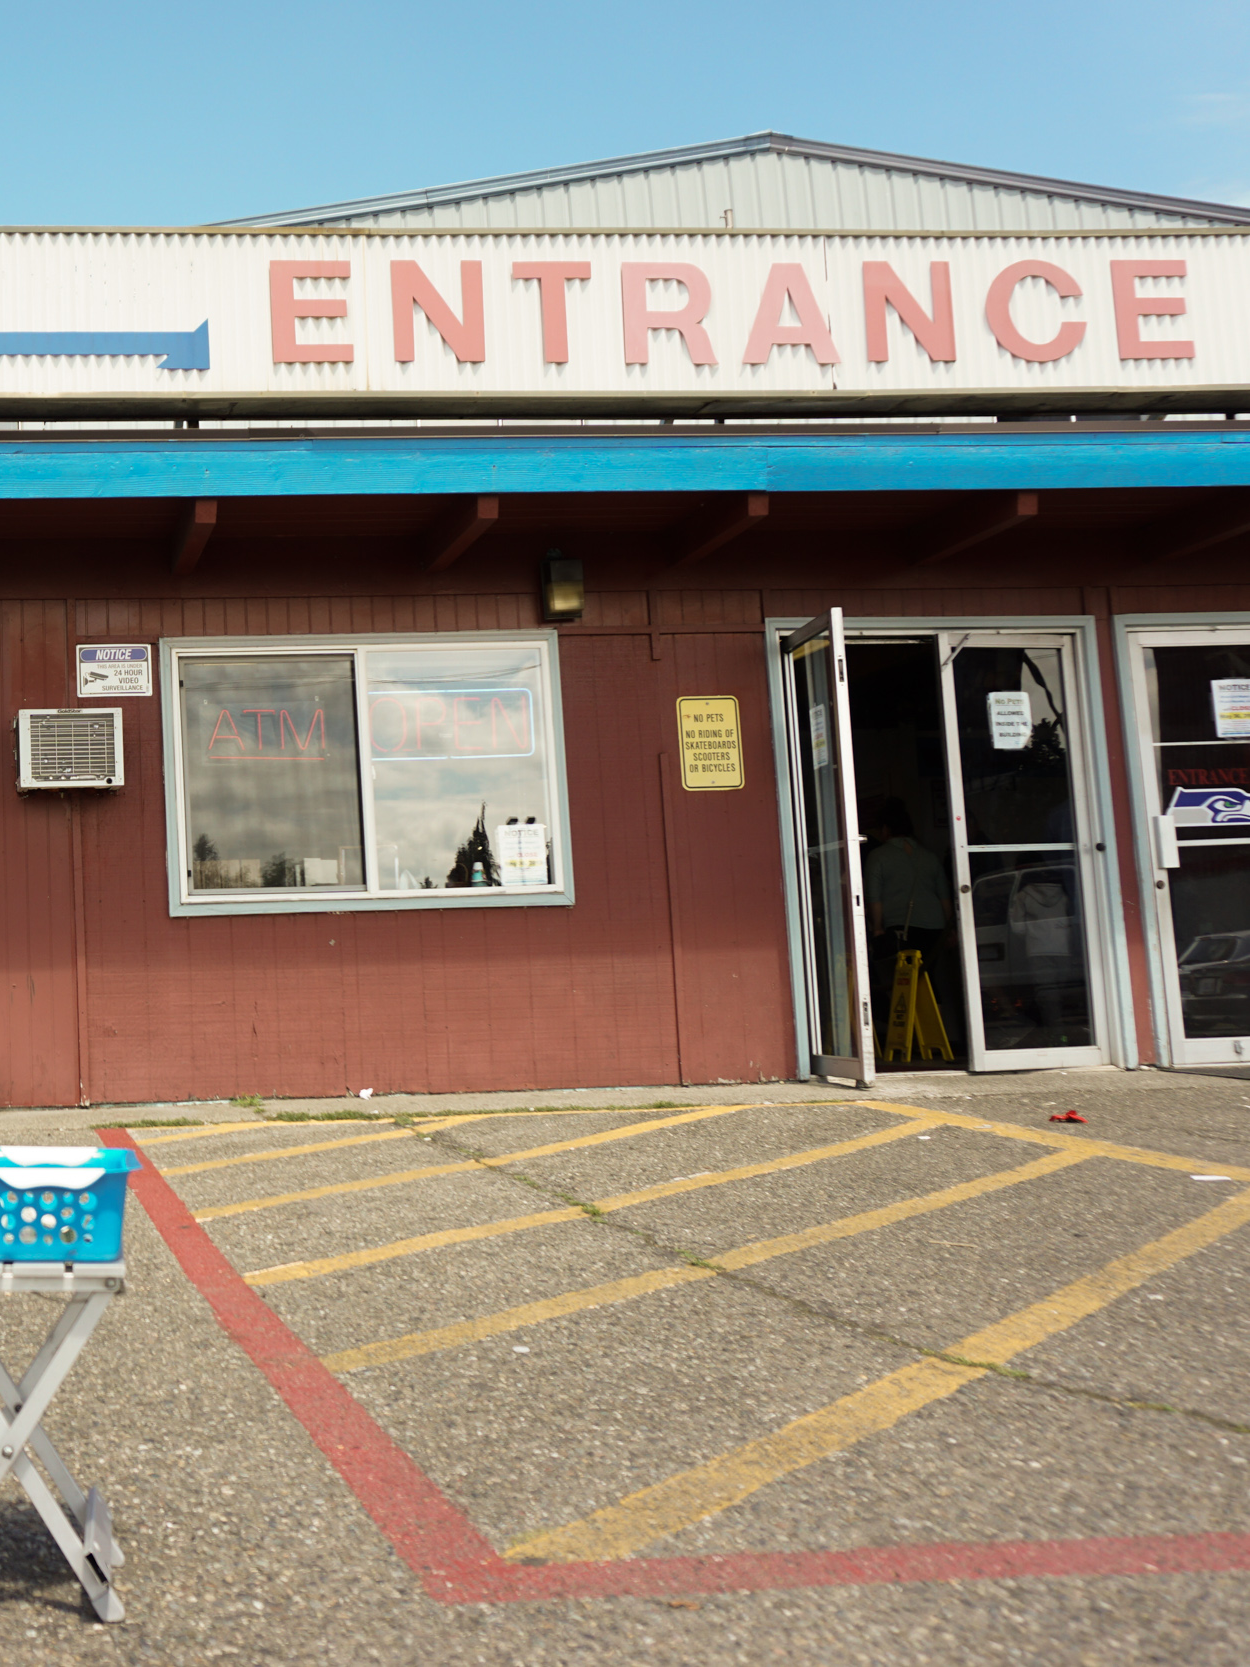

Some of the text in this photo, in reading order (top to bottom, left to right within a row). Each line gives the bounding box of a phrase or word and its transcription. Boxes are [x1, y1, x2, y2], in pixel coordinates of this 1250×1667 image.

[269, 259, 1196, 366] ENTRANCE
[95, 649, 132, 661] NOTICE
[693, 714, 724, 722] NO PETS
[369, 696, 528, 752] OPEN
[208, 709, 325, 750] ATM
[686, 729, 734, 738] NO RIDING OF
[686, 741, 736, 750] SKATEBOARDS
[693, 752, 730, 761] SCOOTERS
[689, 763, 736, 772] OR BICYCLES
[1167, 768, 1250, 785] ENTRANCE
